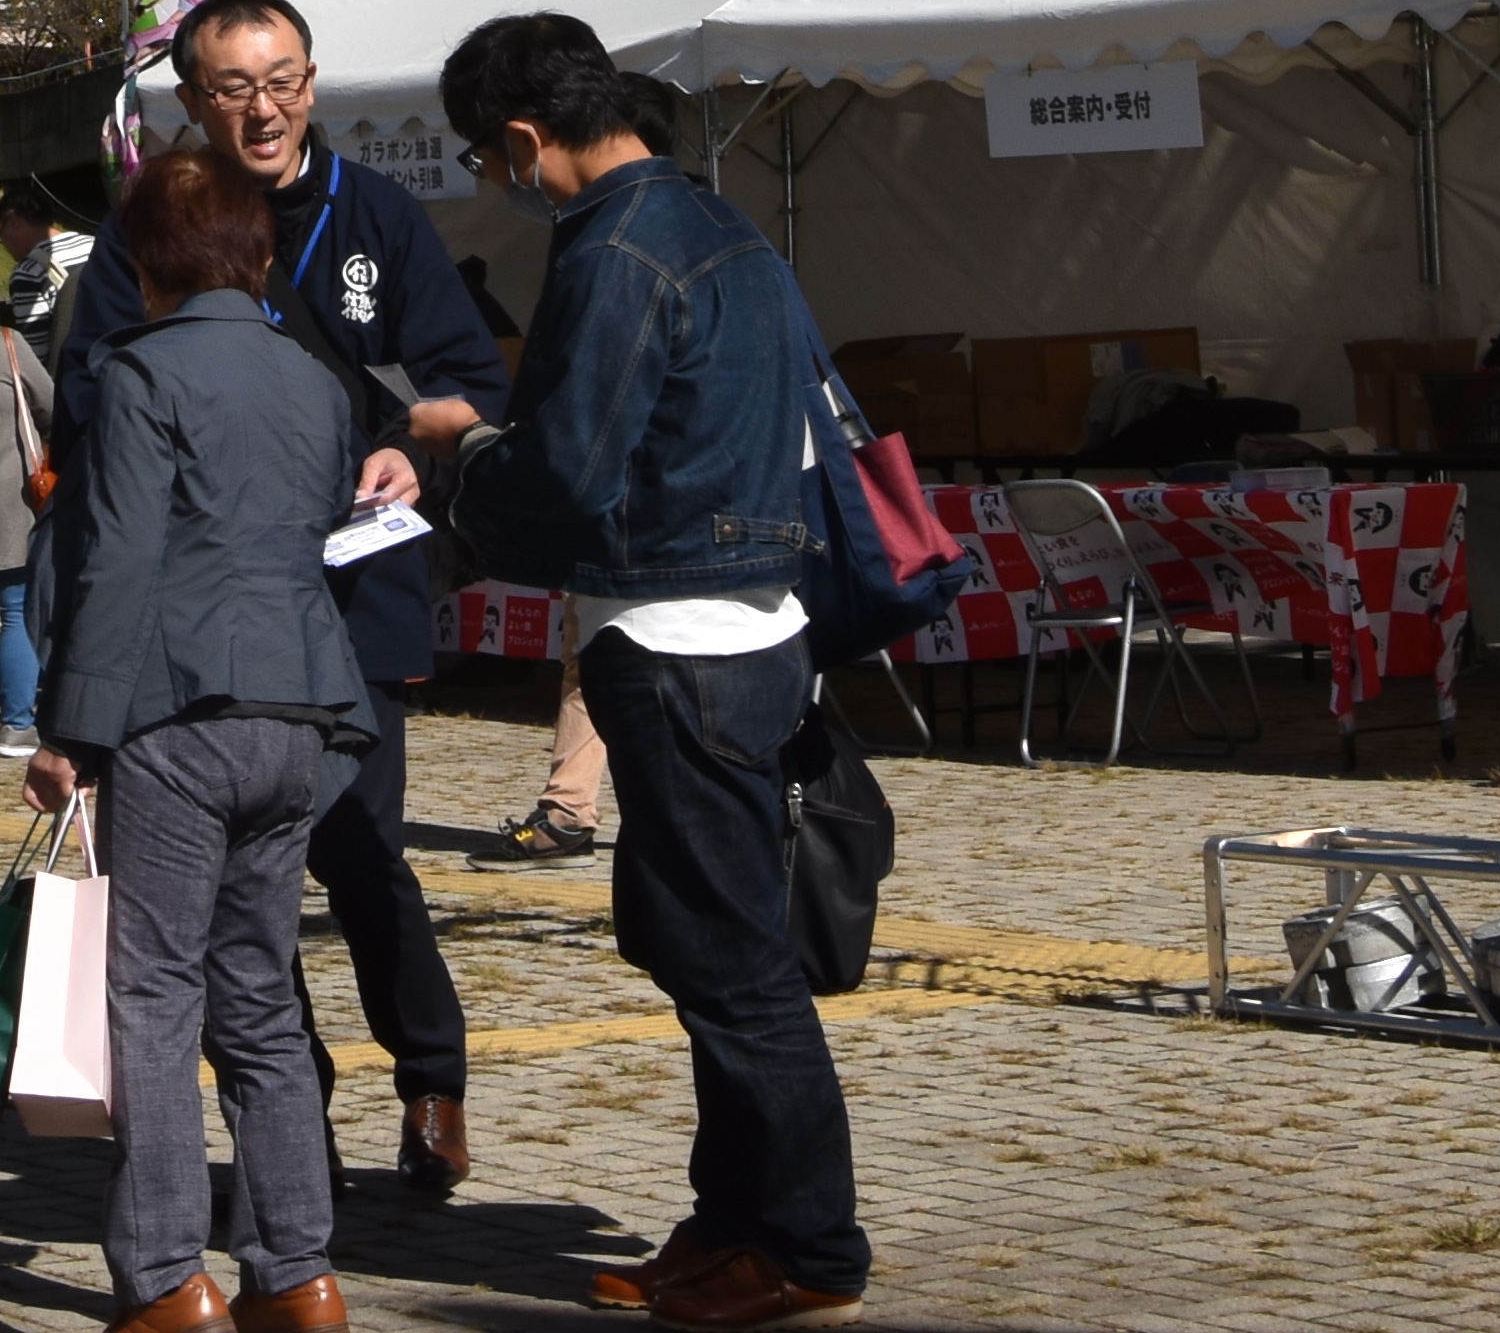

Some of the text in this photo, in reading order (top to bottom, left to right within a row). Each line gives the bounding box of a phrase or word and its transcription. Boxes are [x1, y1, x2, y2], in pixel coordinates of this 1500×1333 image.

[1030, 89, 1151, 126] 総合案内・受付
